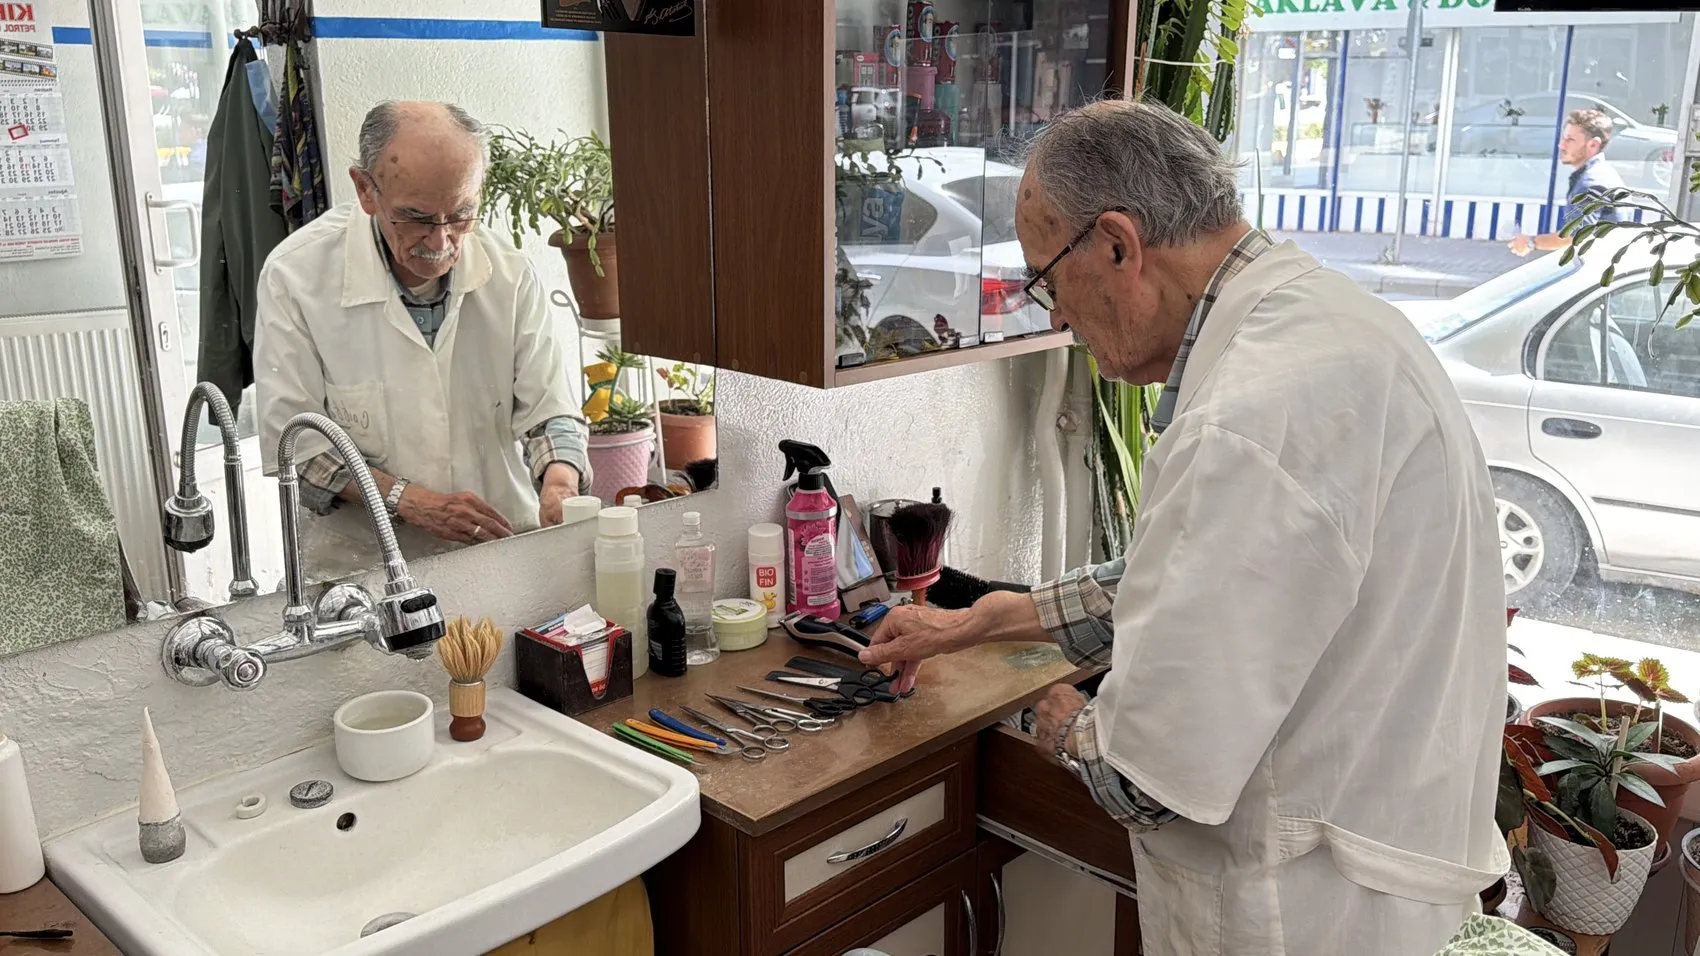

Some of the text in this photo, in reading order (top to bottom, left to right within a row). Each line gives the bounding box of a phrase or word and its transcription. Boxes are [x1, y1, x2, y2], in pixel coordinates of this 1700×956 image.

[1256, 0, 1398, 13] AKLAVA
[758, 568, 774, 576] BIO
[760, 578, 774, 586] FIN
